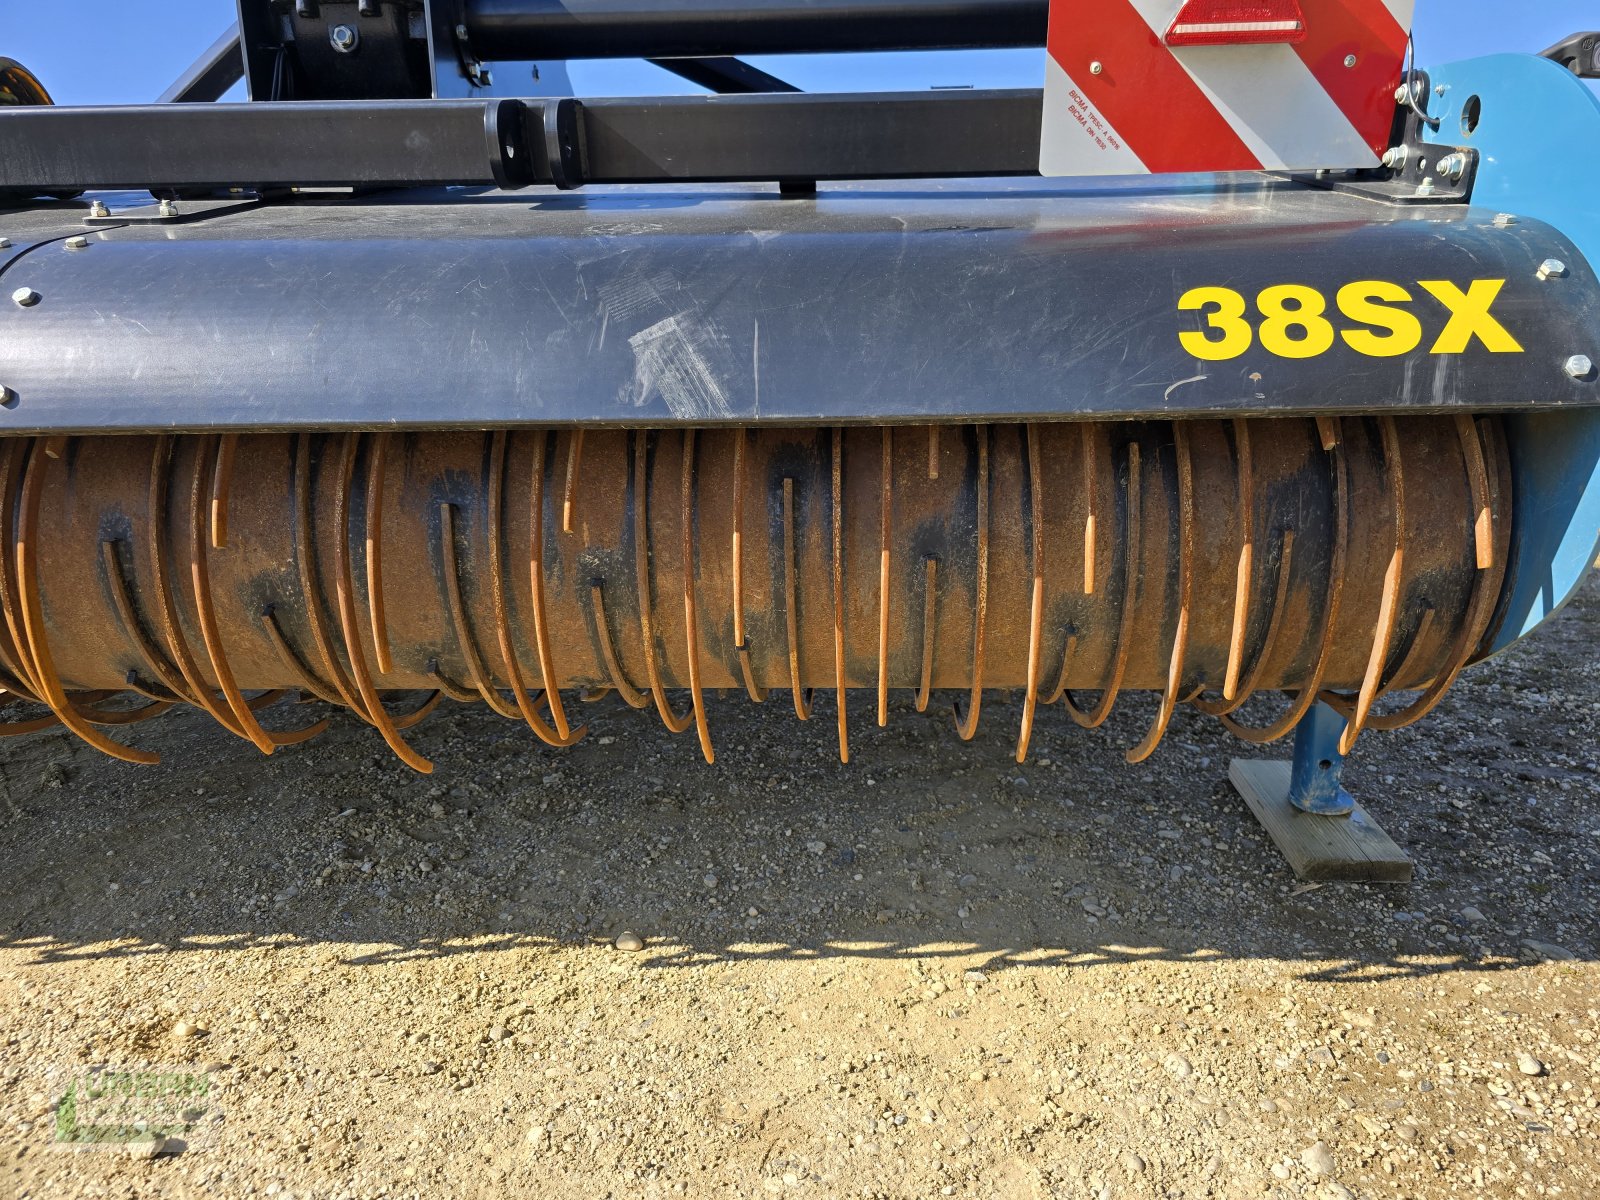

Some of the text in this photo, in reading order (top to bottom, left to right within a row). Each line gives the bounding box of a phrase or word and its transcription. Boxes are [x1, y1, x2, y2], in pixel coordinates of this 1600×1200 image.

[1068, 90, 1088, 112] BICMA
[1068, 105, 1087, 127] BICMA
[1086, 127, 1096, 137] DIN
[1177, 279, 1524, 361] 38SX
